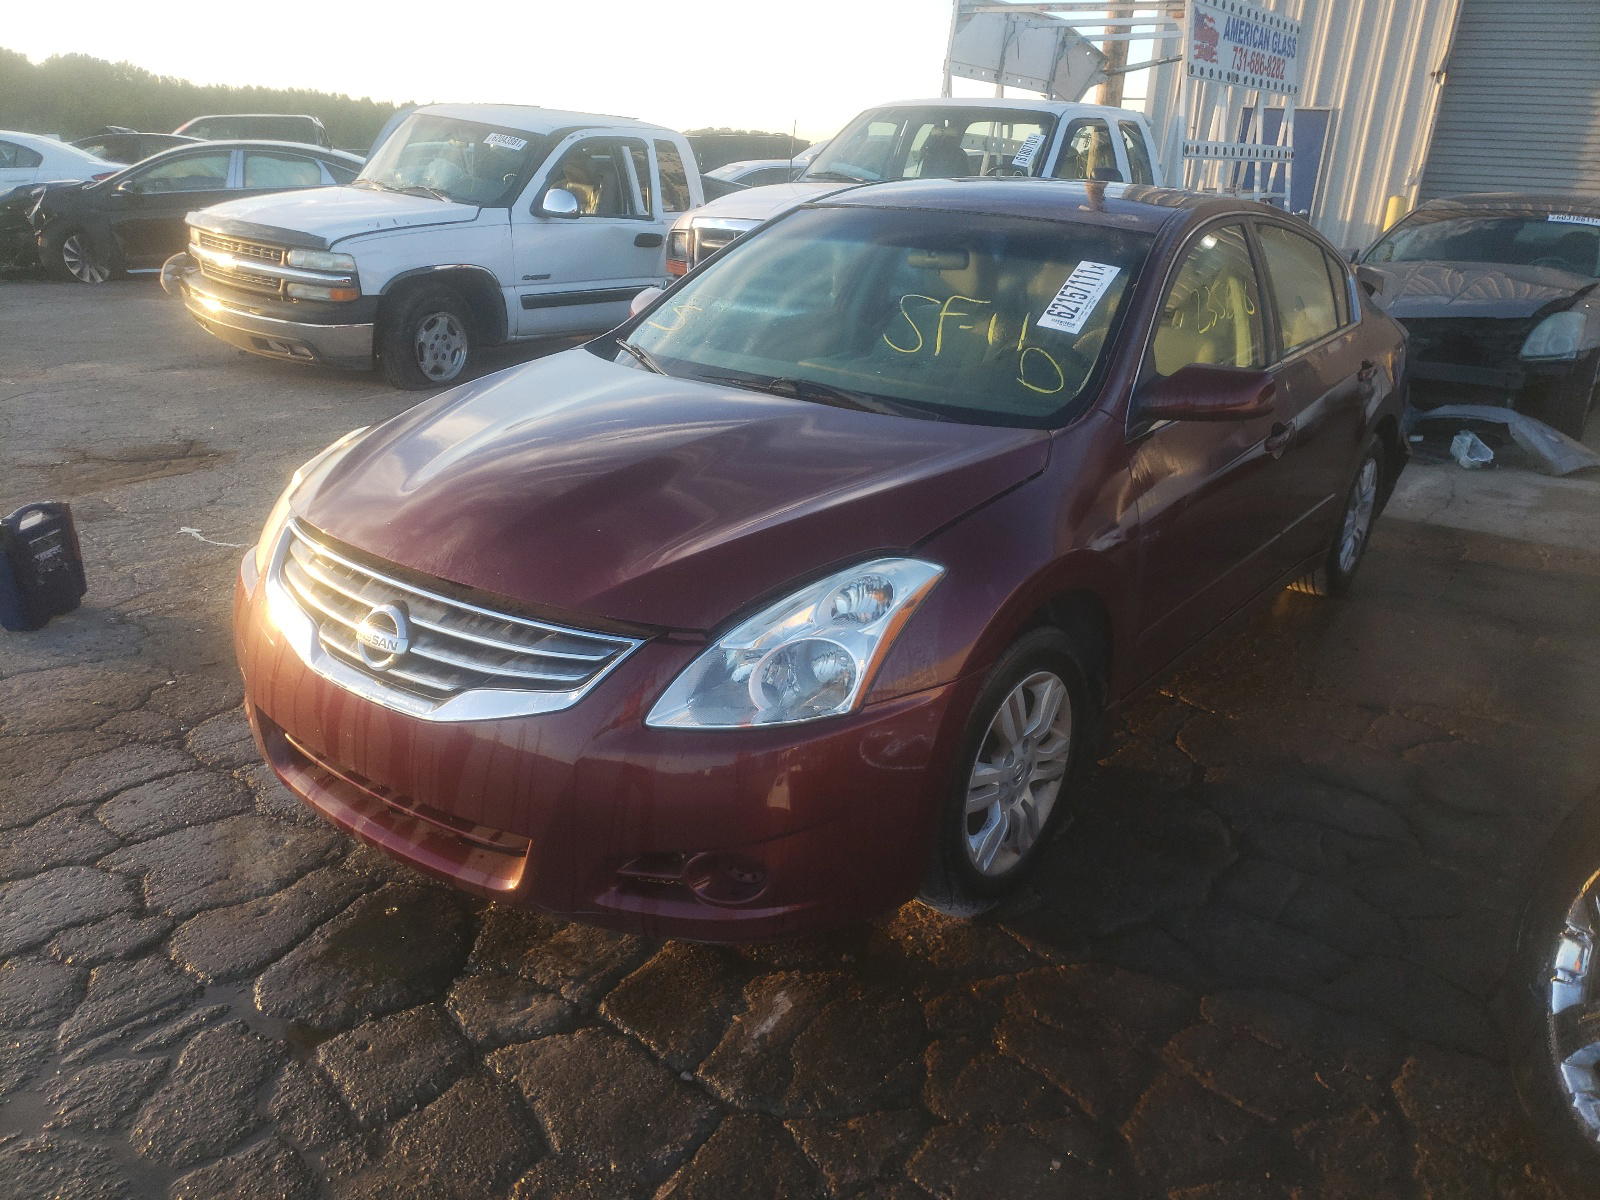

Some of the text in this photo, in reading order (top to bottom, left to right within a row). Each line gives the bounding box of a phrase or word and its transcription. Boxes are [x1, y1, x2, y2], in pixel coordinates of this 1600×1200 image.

[1223, 15, 1297, 59] AMERICAN GLASS
[357, 632, 399, 651] SSAN
